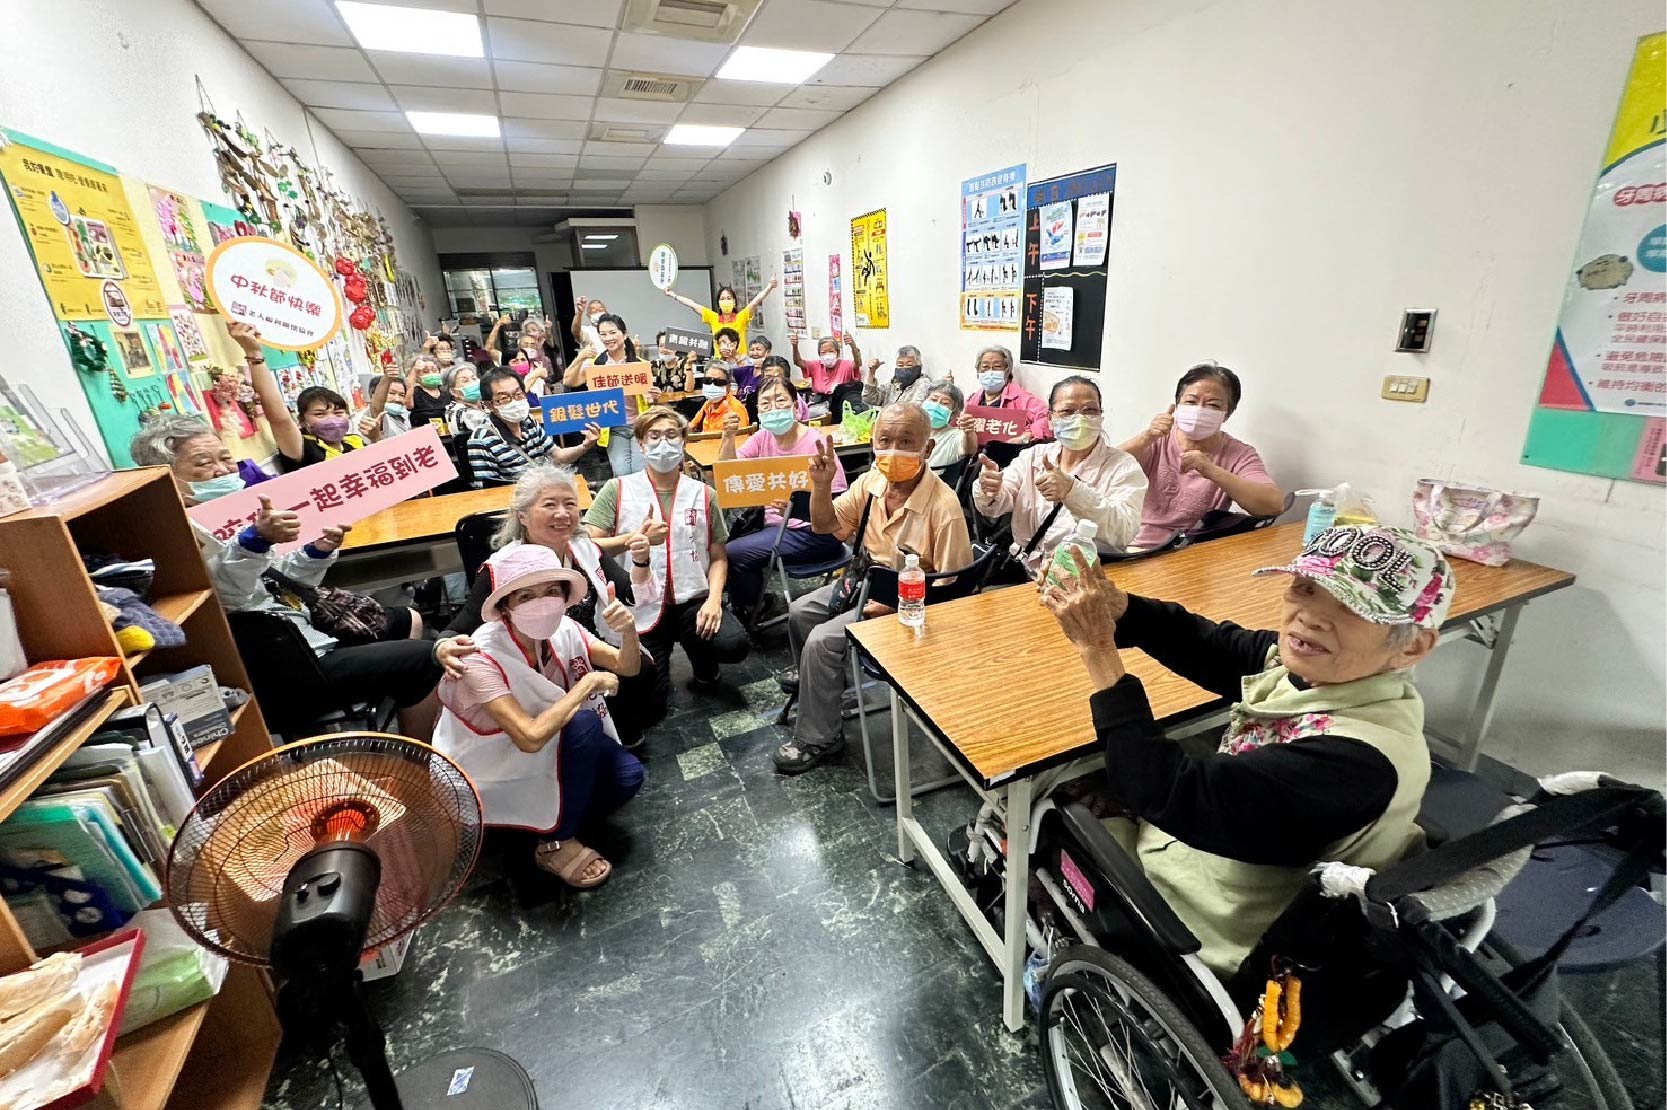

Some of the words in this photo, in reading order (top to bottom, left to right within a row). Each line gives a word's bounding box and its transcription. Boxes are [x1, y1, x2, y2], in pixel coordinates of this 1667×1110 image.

[230, 273, 321, 317] 中秋節快樂
[1025, 293, 1037, 341] 下午
[592, 373, 648, 388] 佳節送暖
[549, 400, 619, 422] 銀髮世代
[723, 471, 809, 493] 傳愛共好
